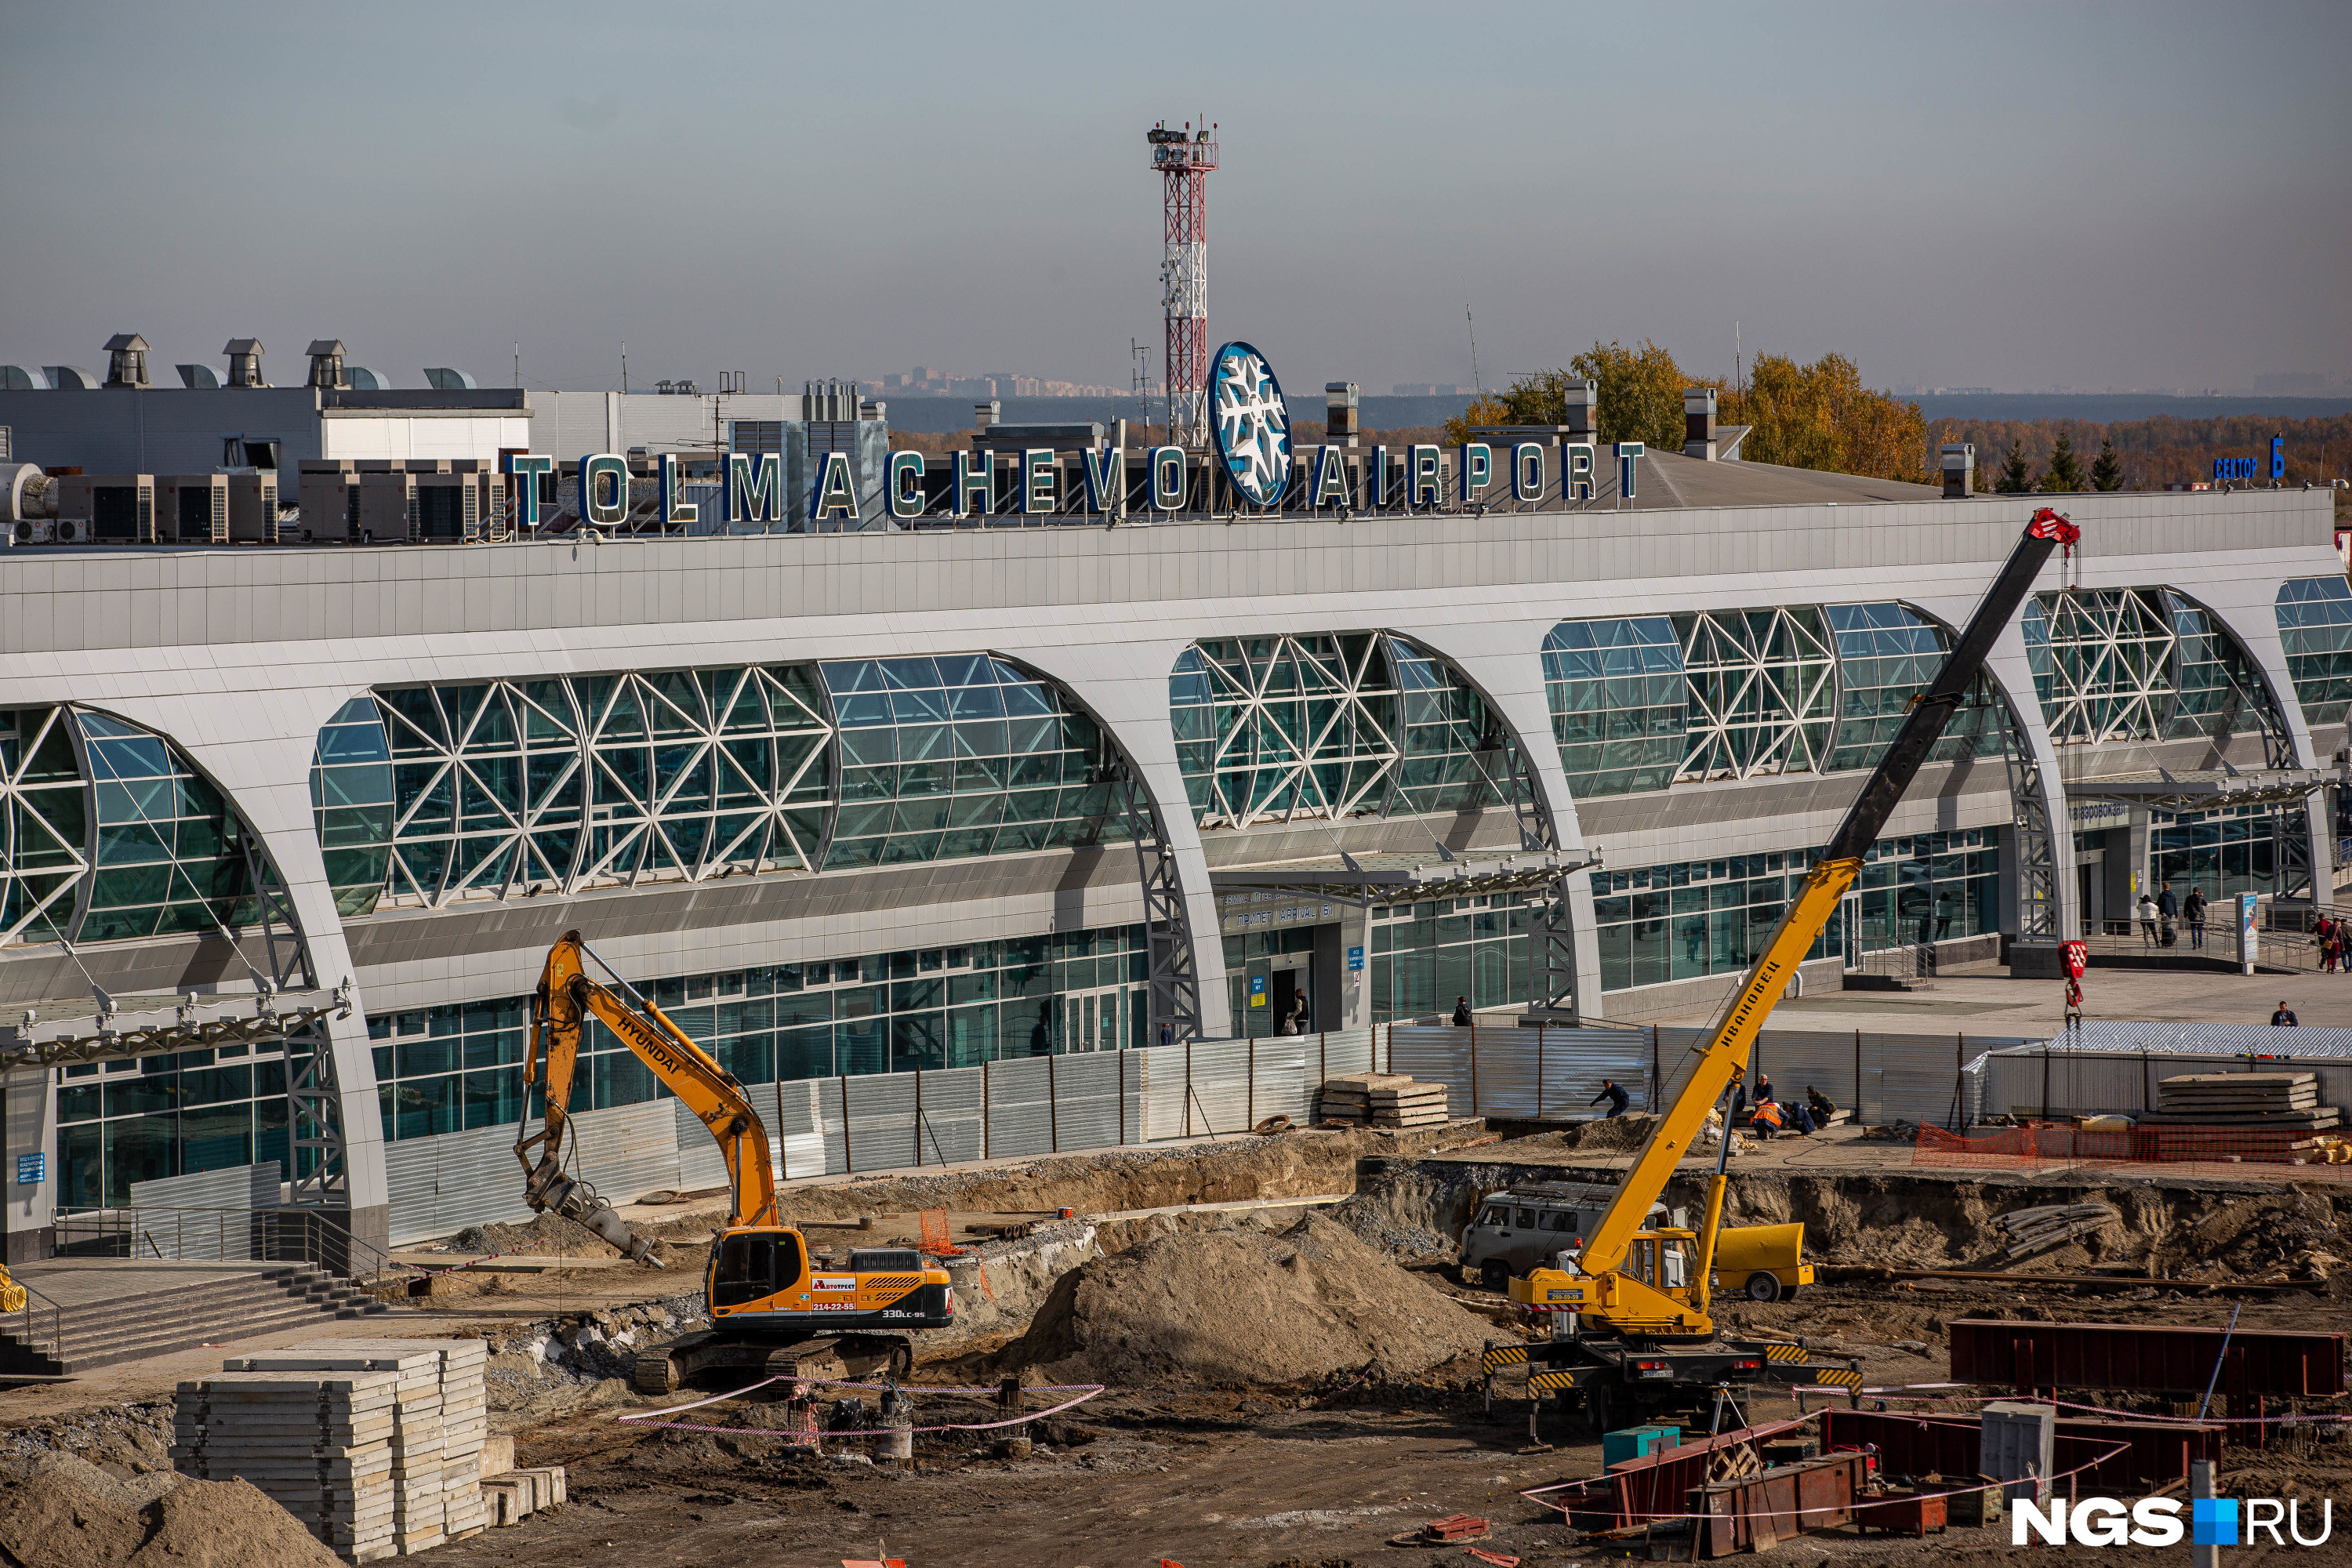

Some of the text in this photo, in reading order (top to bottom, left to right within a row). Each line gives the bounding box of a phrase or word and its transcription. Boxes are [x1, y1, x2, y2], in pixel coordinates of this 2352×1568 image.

[2213, 437, 2285, 478] СЕКТОР Б
[506, 442, 1645, 526] TOLMACHEVO AIRPORT
[1220, 893, 1253, 906] TERMINAL
[1237, 910, 1272, 927] ПРИЛЕТ
[1280, 906, 1316, 922] ARRIVAL
[1323, 903, 1334, 917] Б1
[1720, 960, 1781, 1048] ИВАНОВЕЦ
[617, 1017, 681, 1075] HYUNDAI
[813, 1302, 855, 1311] 214-22-55
